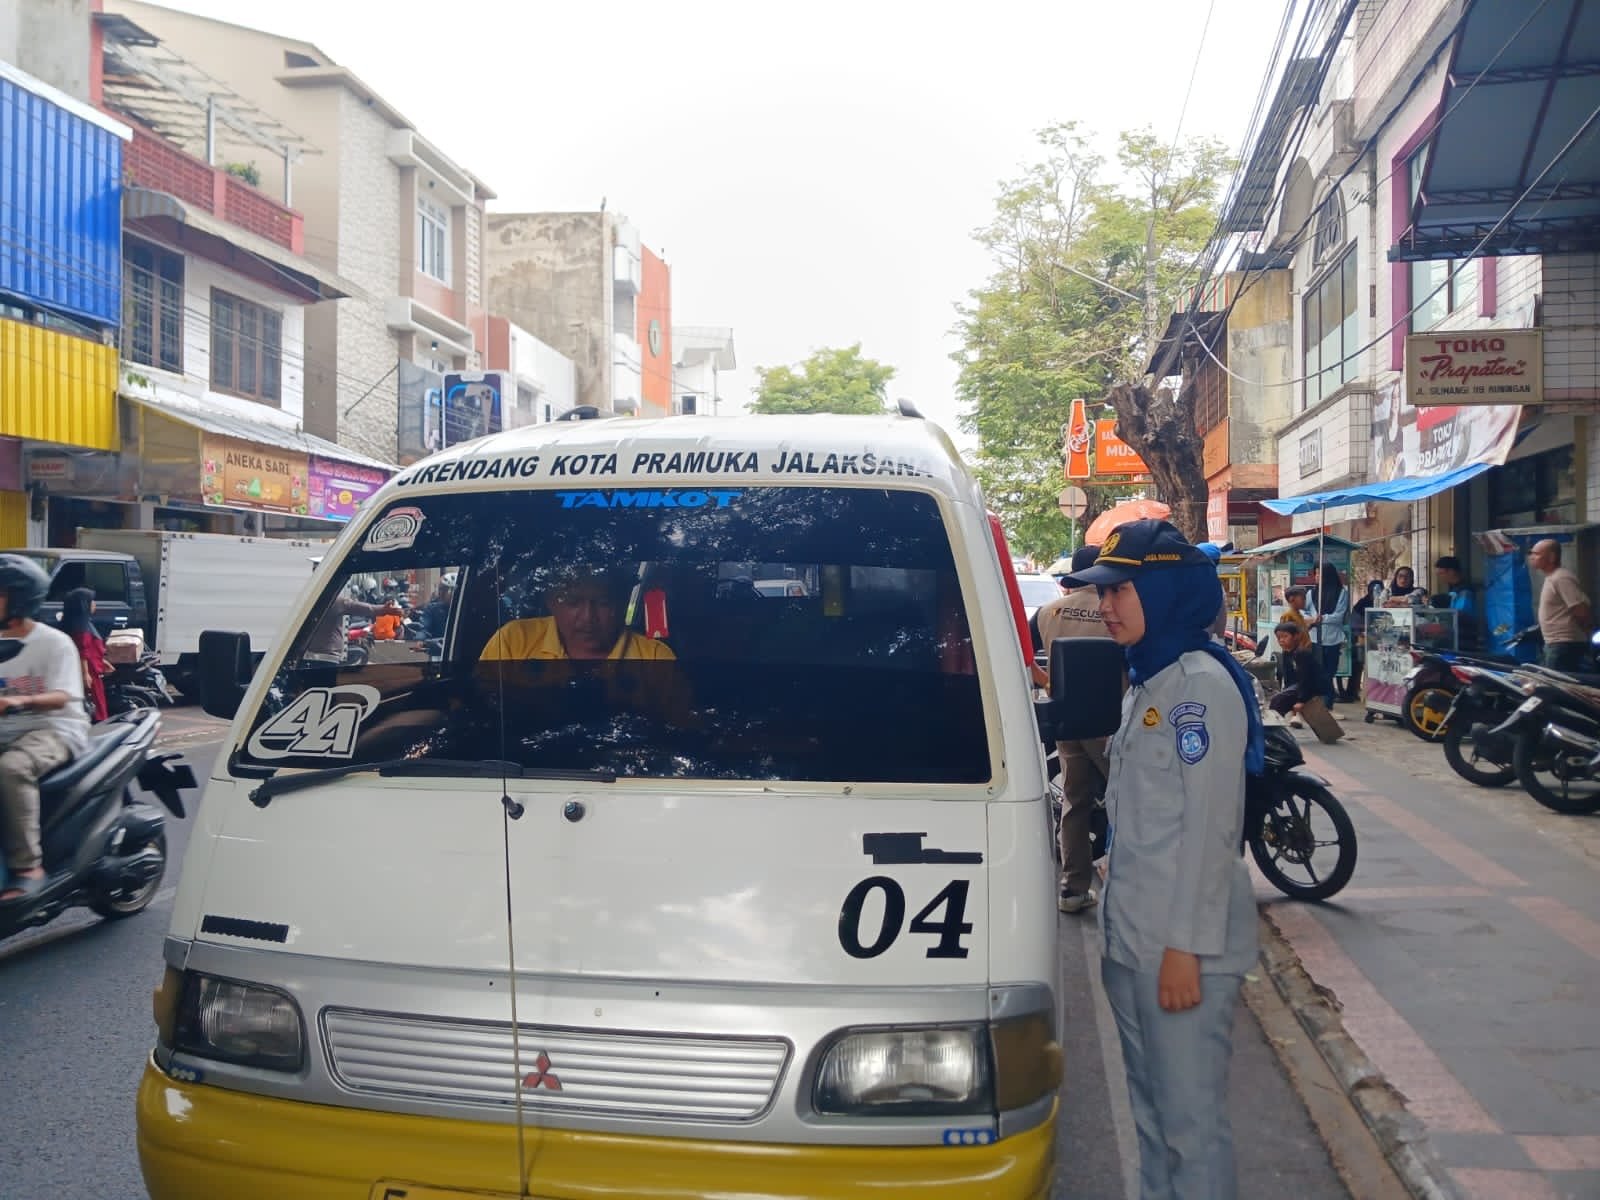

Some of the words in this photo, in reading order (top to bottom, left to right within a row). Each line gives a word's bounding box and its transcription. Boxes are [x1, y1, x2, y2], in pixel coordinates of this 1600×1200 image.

[1435, 338, 1505, 353] TOKO
[226, 452, 263, 471] ANEKA
[265, 461, 290, 476] SARI
[550, 453, 617, 476] KOTA
[631, 452, 759, 474] PRAMUKA
[555, 491, 743, 508] TAMKOT
[838, 876, 973, 959] 04
